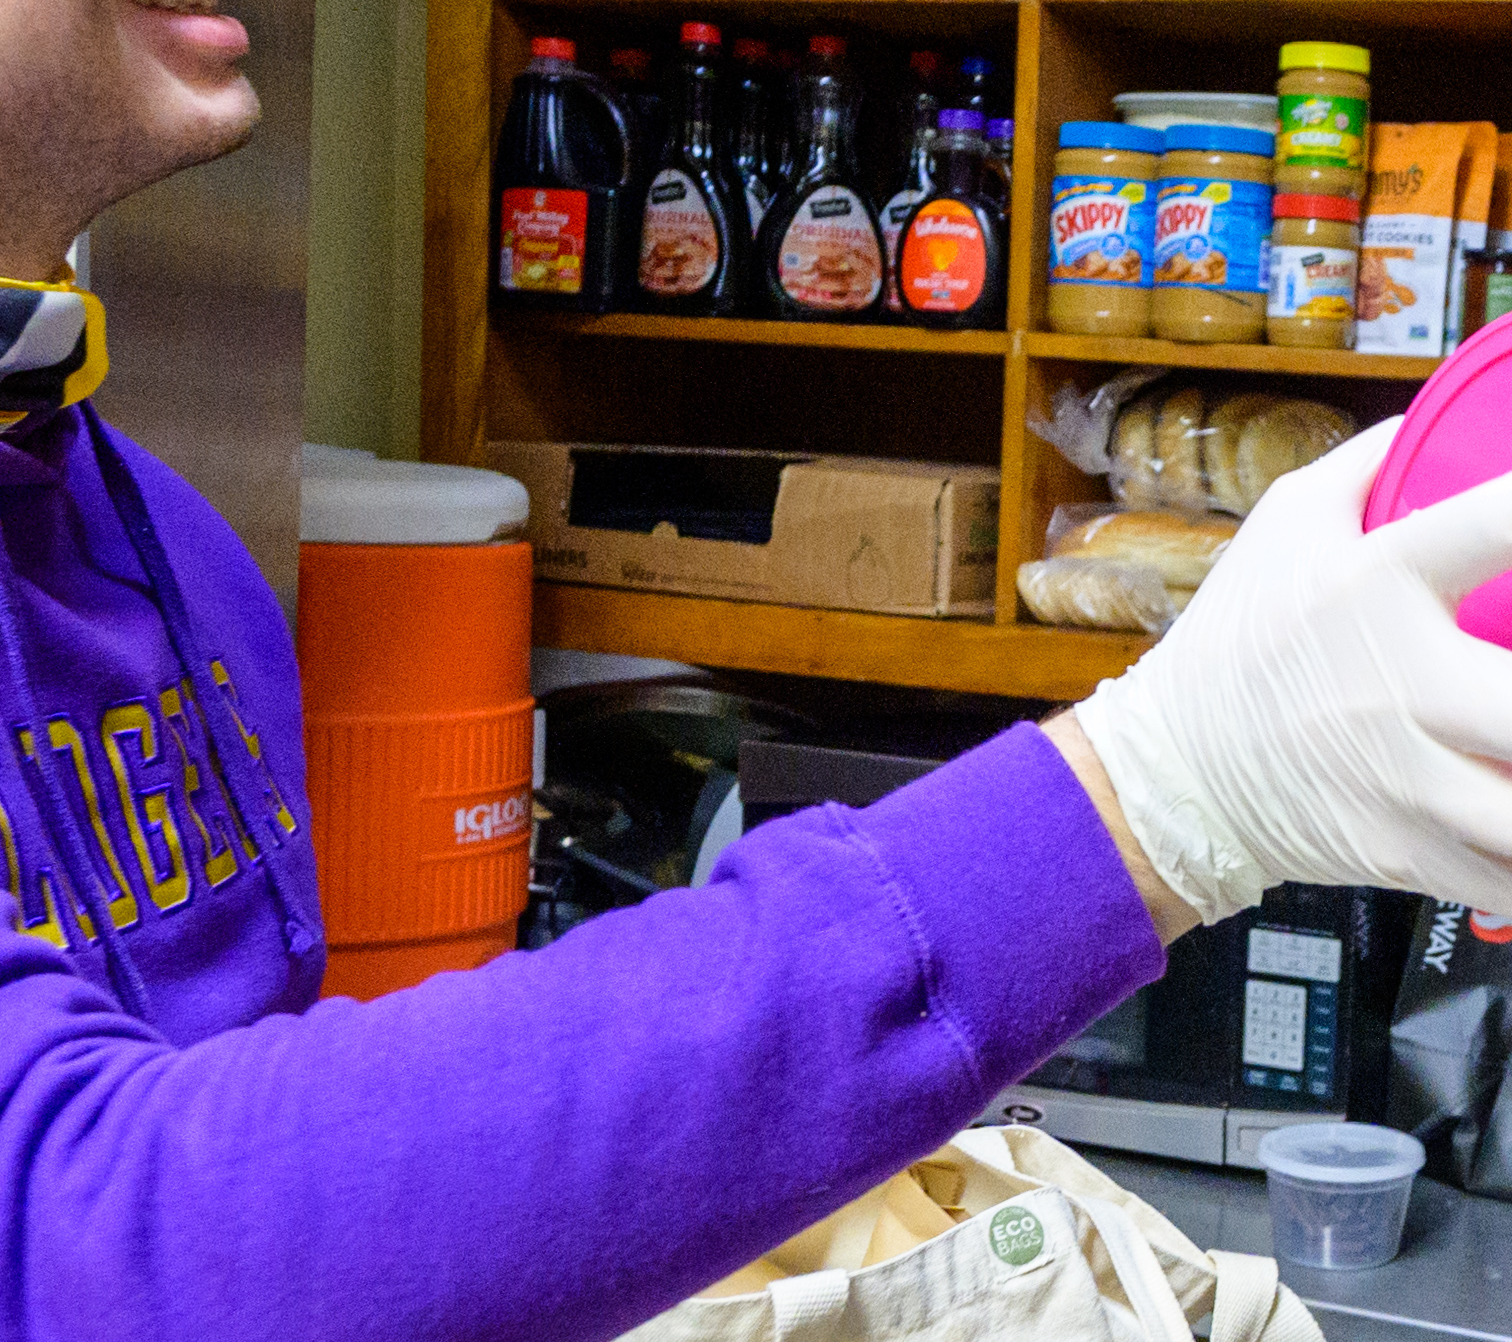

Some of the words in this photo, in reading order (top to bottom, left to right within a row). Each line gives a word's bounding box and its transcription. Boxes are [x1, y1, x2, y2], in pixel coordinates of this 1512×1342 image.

[1054, 202, 1125, 245] SKIPPY
[1377, 232, 1434, 245] COOKIES
[992, 1216, 1036, 1241] ECO
[996, 1230, 1042, 1256] BAGS
